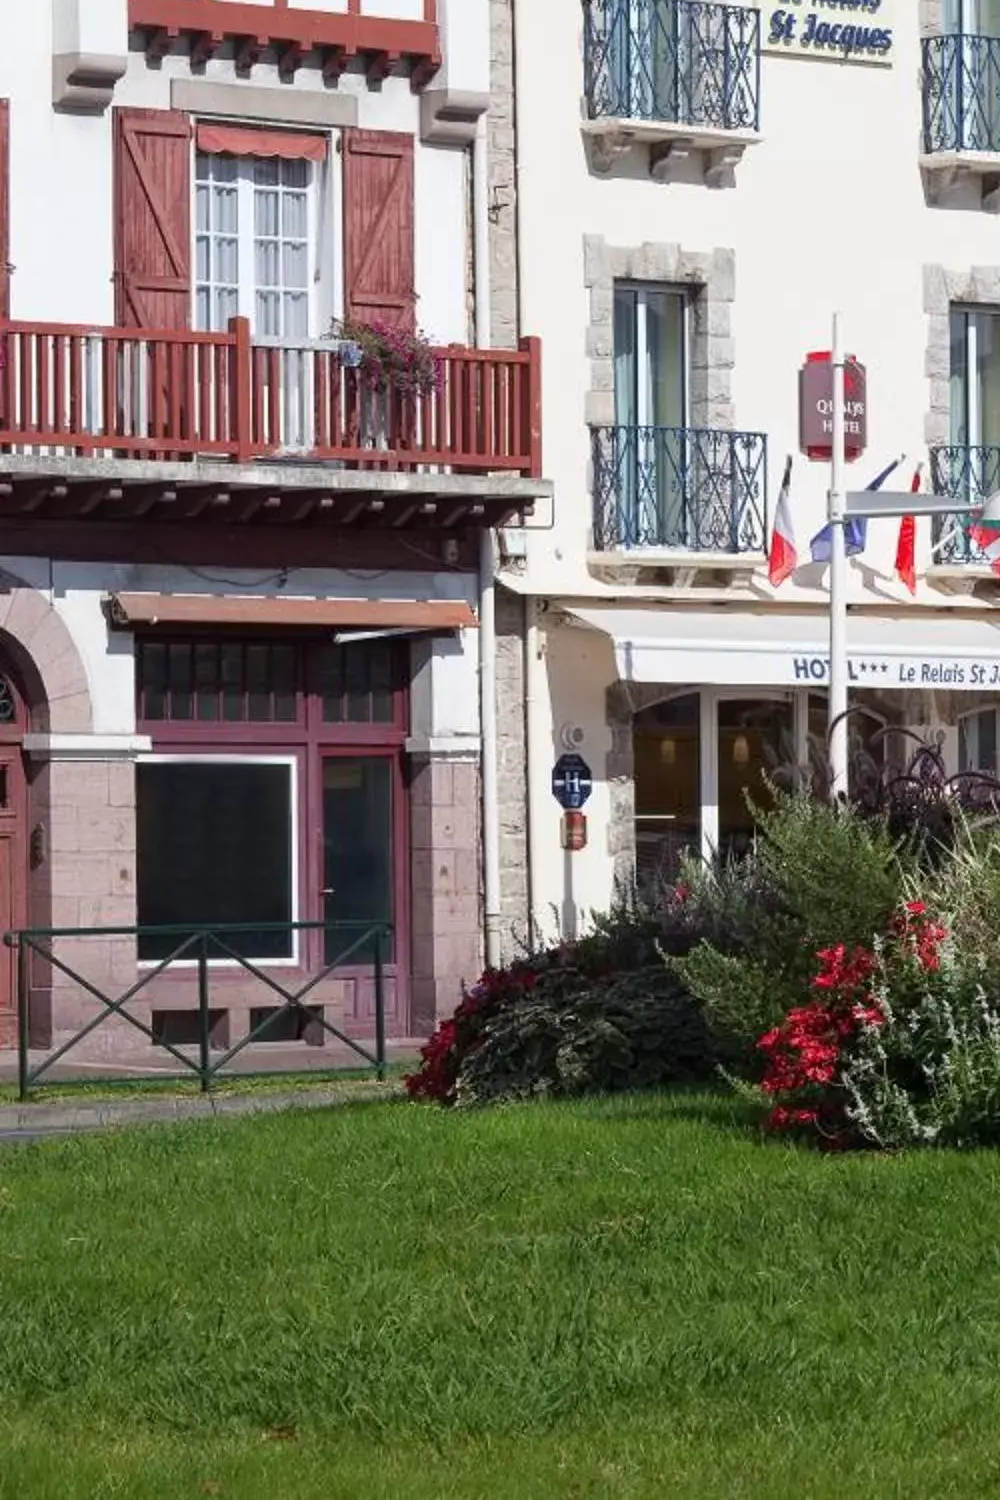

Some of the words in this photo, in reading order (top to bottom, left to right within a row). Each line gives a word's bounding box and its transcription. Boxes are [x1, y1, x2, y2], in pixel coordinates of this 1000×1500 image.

[768, 8, 797, 45] St
[800, 13, 893, 60] Jacques
[823, 419, 860, 434] HEL
[793, 658, 859, 681] HOL
[899, 663, 916, 682] Le
[921, 663, 965, 683] Relais
[969, 664, 986, 684] St
